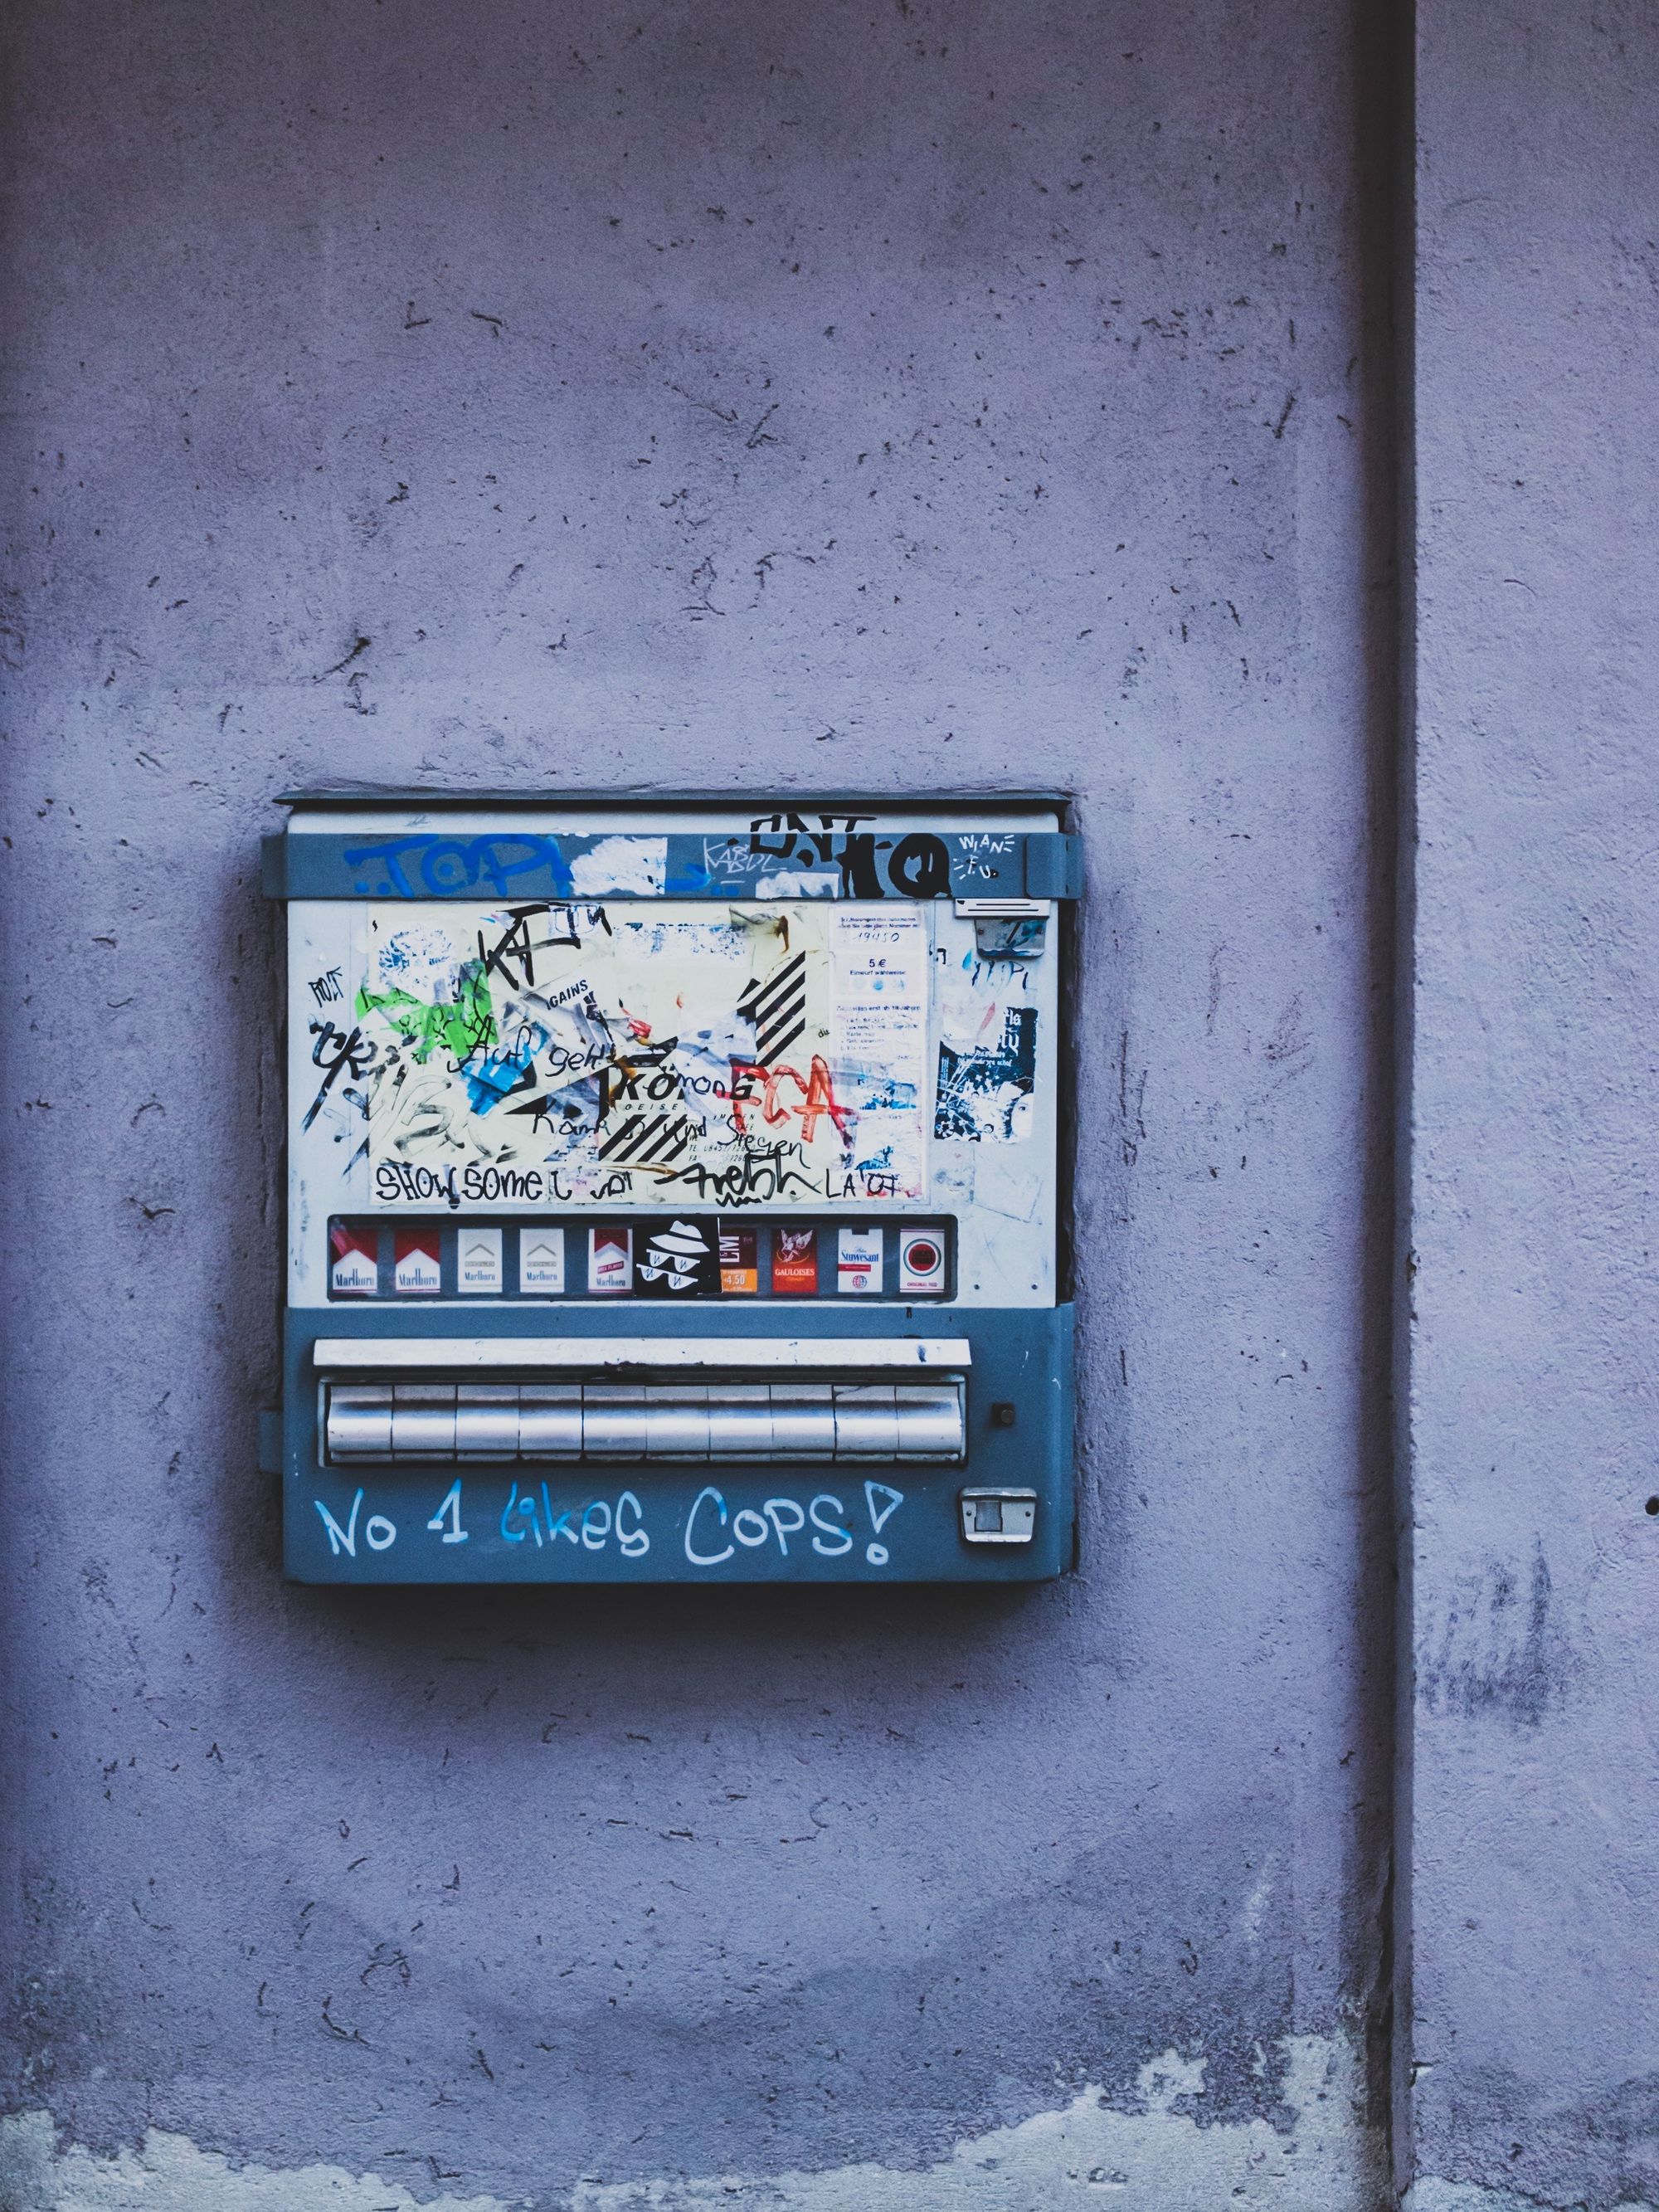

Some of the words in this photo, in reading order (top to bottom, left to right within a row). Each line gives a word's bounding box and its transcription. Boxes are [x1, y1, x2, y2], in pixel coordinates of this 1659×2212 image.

[868, 958, 875, 967] 5
[878, 958, 887, 967] €
[335, 1268, 375, 1287] Marlboro
[398, 1268, 438, 1287] Marlboro
[465, 1270, 496, 1280] Marlboro
[527, 1270, 557, 1281] Marlboro
[775, 1268, 815, 1276] GAULOISES
[596, 1274, 626, 1287] Marlboro
[314, 1488, 397, 1557] No
[426, 1479, 469, 1543] 1
